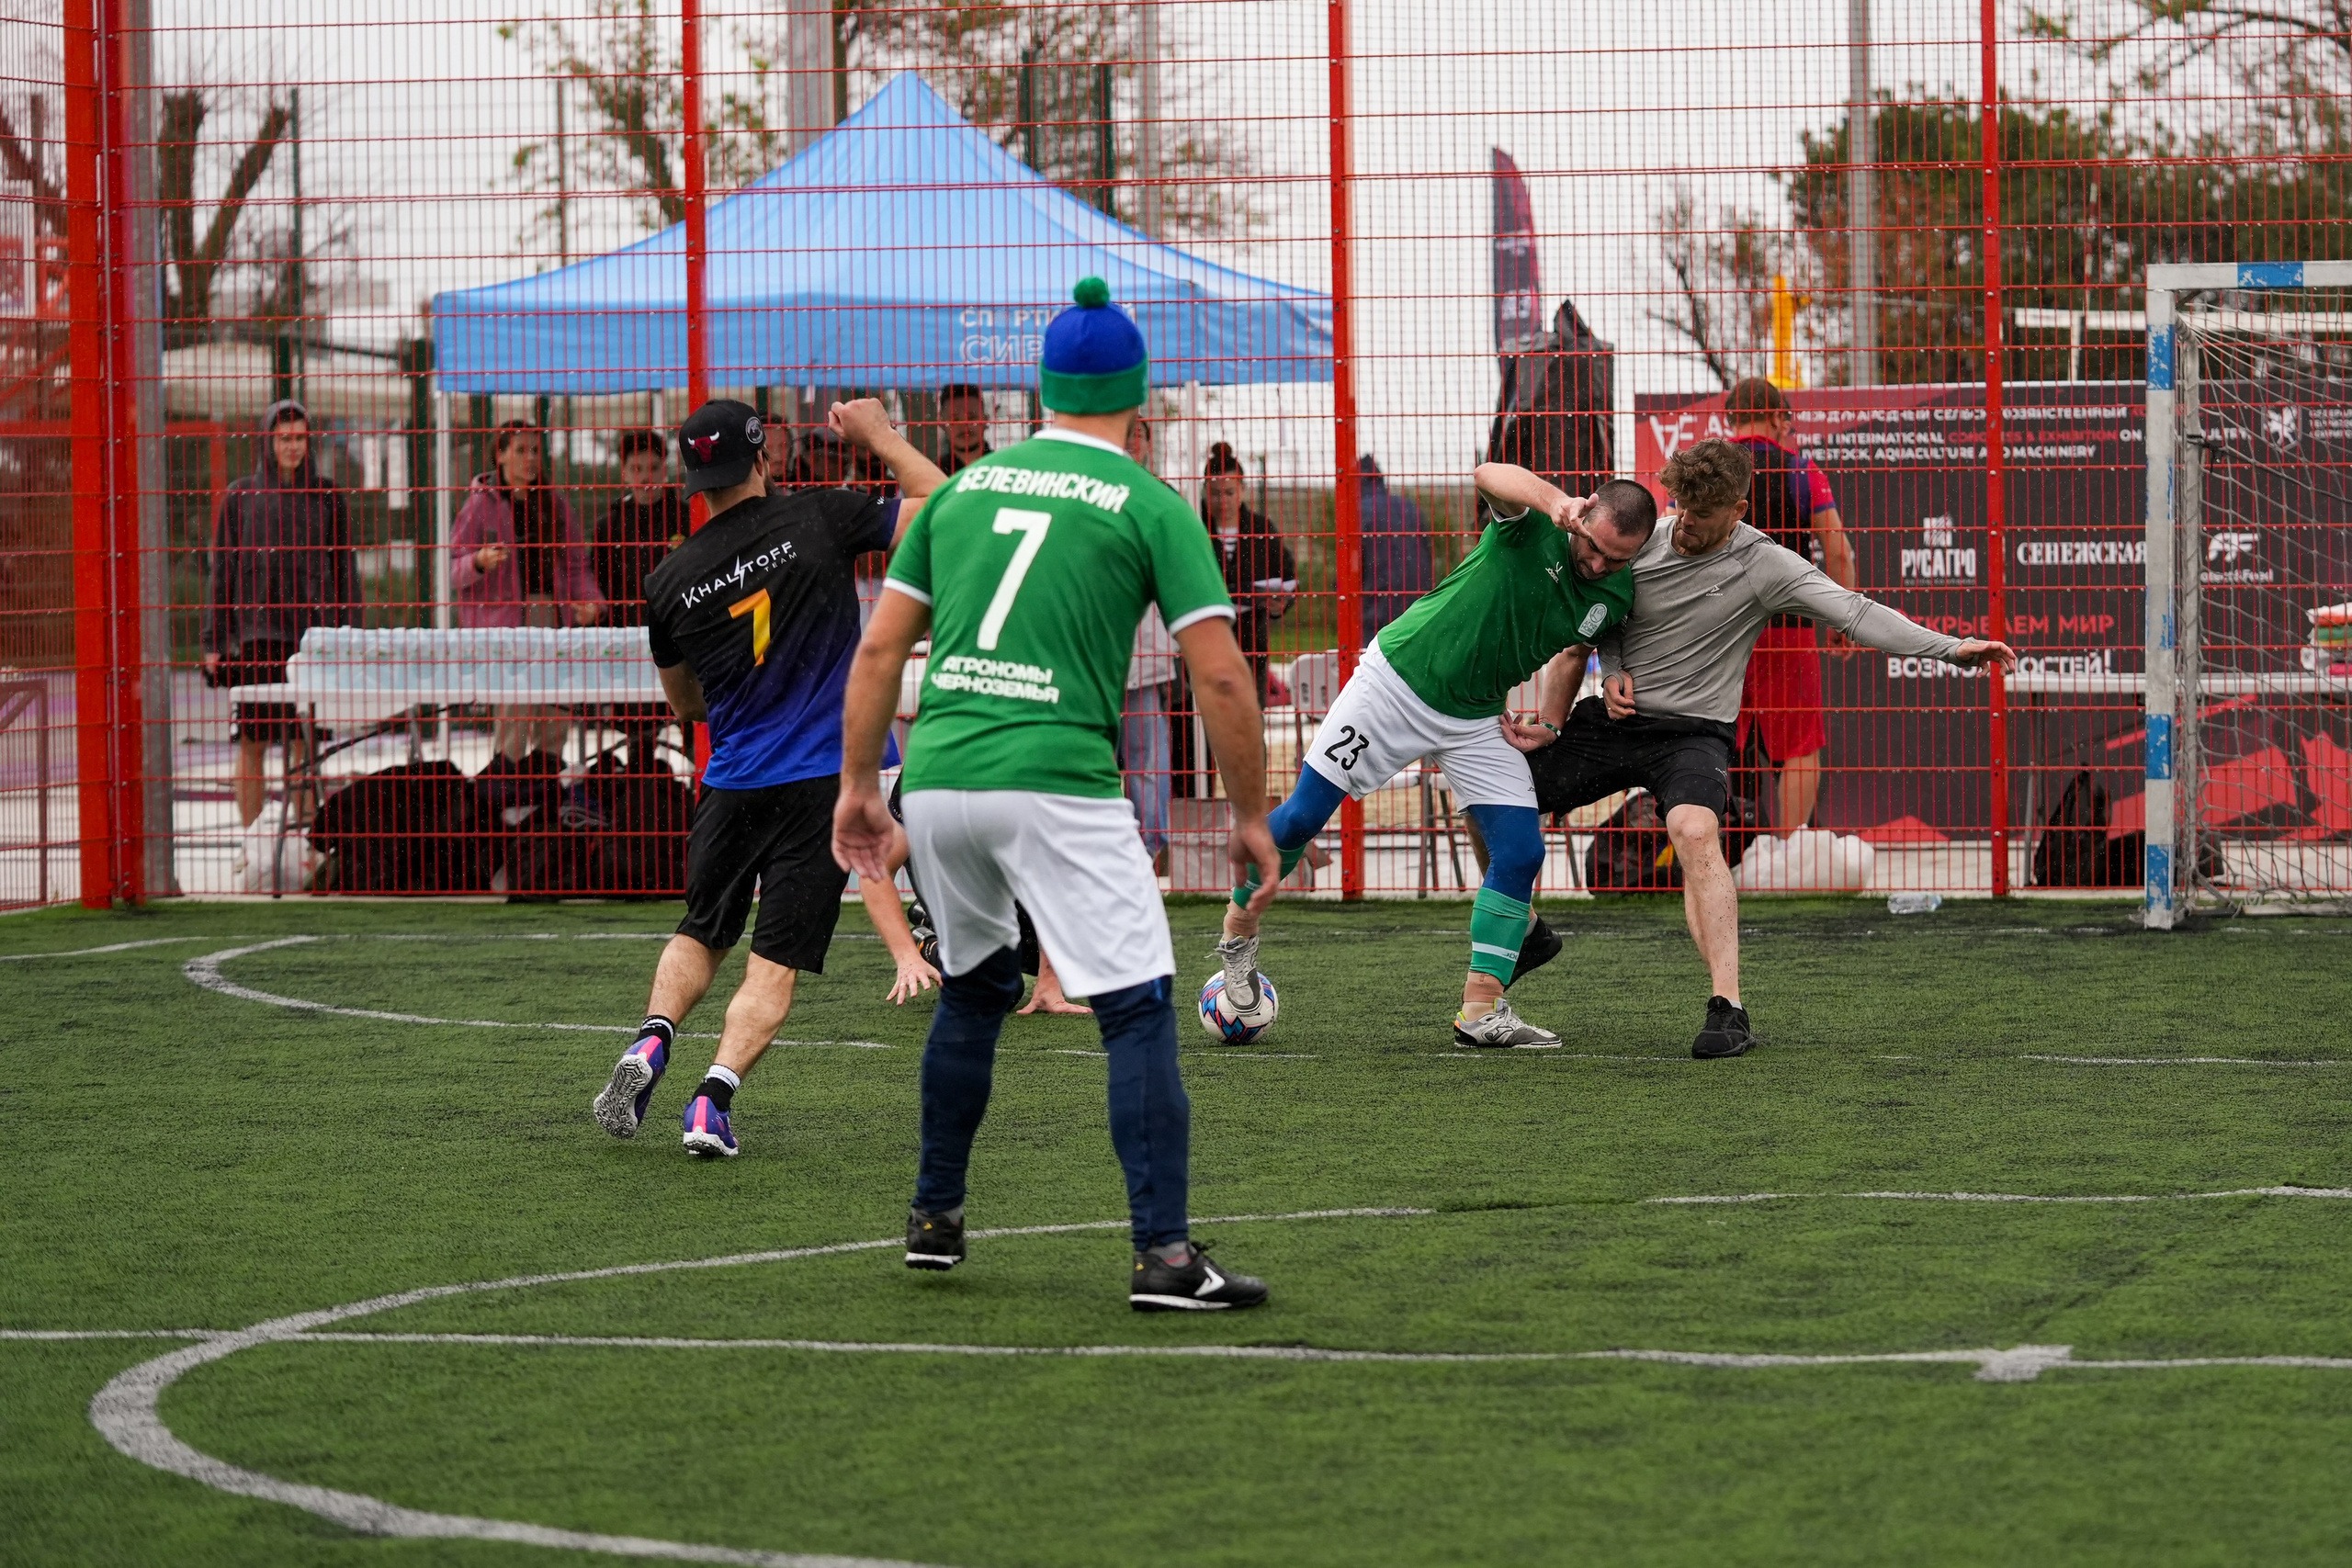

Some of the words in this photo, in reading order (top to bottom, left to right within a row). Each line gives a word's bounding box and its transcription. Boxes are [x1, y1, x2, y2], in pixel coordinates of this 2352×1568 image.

[1836, 431, 1945, 446] INTERNATIONAL
[2120, 428, 2143, 443] ON
[1874, 446, 1974, 462] AQUACULTURE
[2013, 445, 2097, 459] MACHINERY
[764, 551, 797, 572] TEAM
[1901, 547, 1976, 579] РУСАГРО
[2017, 540, 2147, 566] СЕНЕЖСКАЯ
[977, 507, 1053, 651] 7
[728, 588, 771, 667] 7
[2058, 614, 2115, 636] МИР
[942, 655, 1053, 684] АГРОНОМЫ
[931, 672, 1060, 704] ЧЕРНОЗЕМЬЯ
[1324, 725, 1370, 771] 23
